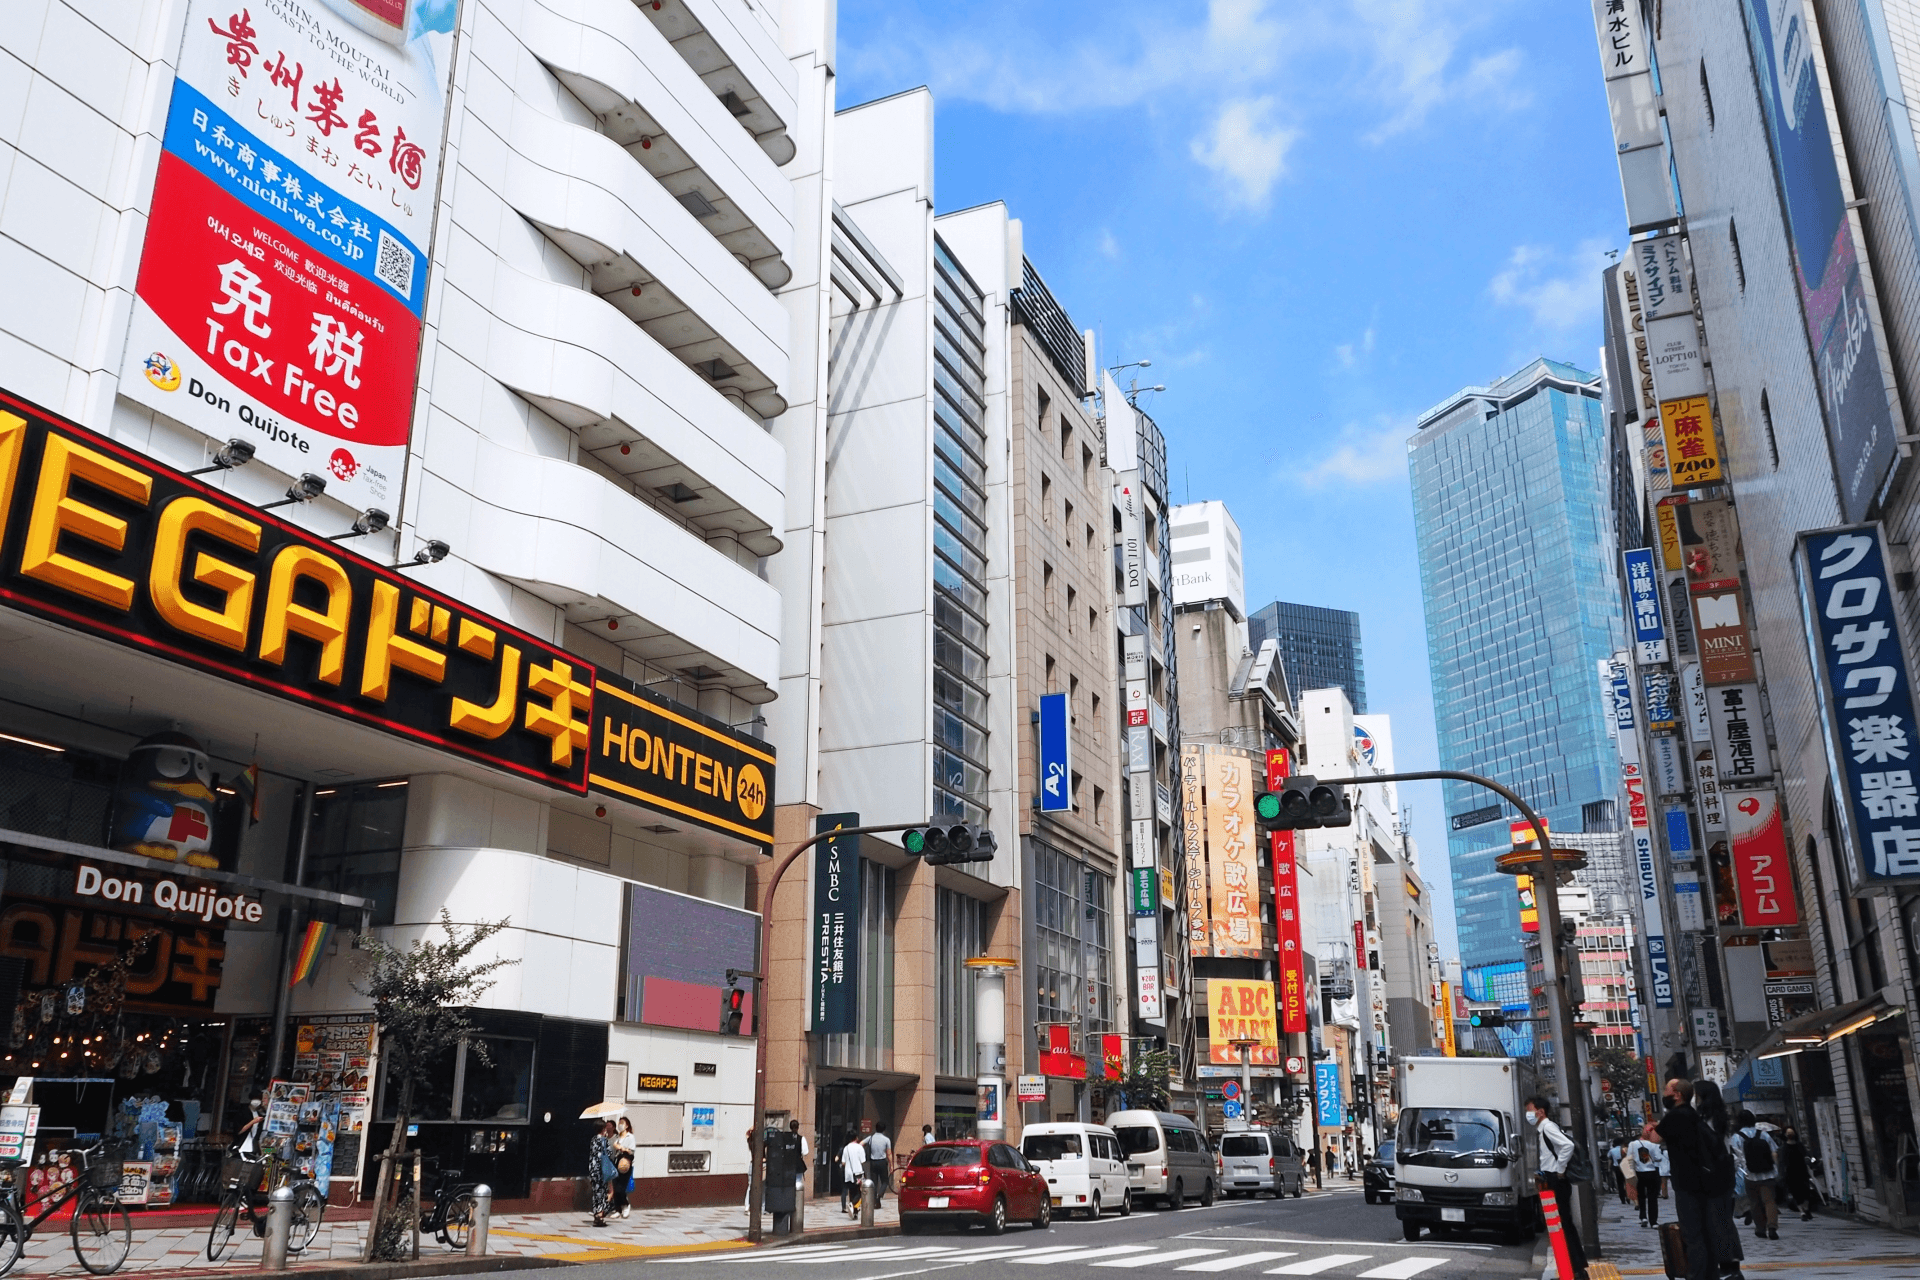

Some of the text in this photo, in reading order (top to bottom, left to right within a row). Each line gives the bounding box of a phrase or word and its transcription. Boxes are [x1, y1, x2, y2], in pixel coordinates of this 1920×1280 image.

[278, 0, 390, 80] HINA MOUTAI
[1606, 0, 1633, 67] 清水ビル
[308, 32, 326, 50] TO
[328, 46, 354, 73] THE
[358, 67, 405, 105] WORLD
[227, 75, 241, 97] き
[306, 135, 338, 167] まお
[347, 162, 383, 191] たい
[192, 107, 373, 242] 日和商事株式会社
[194, 138, 364, 260] www.nichi-wa.co.jp
[207, 216, 266, 261] 어서 오세요
[252, 226, 299, 263] WELCOME
[1663, 240, 1683, 294] ベトナム料理
[211, 258, 366, 390] 免税
[205, 316, 360, 431] Tax Free
[1656, 350, 1697, 365] LOFT101
[1667, 367, 1690, 375] SHIBUYA
[1825, 286, 1868, 441] Fender
[188, 377, 310, 454] Don Quijote
[1664, 402, 1705, 415] フリー
[1674, 415, 1708, 460] 麻雀
[362, 473, 387, 491] Tax-free
[1673, 457, 1715, 475] ZOO
[1684, 472, 1710, 483] 4F
[1667, 497, 1680, 506] 6F
[1660, 509, 1679, 553] エステ
[0, 408, 590, 769] EGAドンキ
[1128, 562, 1139, 588] DOT
[1631, 561, 1659, 631] 洋服の青山
[1644, 641, 1660, 650] 2F
[1646, 652, 1662, 661] 1F
[1703, 634, 1744, 651] MINT
[1613, 685, 1634, 727] LABI
[1819, 534, 1920, 876] クロサワ楽器店
[1721, 688, 1755, 776] 富士屋酒店
[602, 714, 765, 808] HONTEN 24h
[1045, 761, 1065, 797] A2
[1626, 778, 1649, 828] LABI
[1699, 765, 1723, 825] 韓国料理
[828, 846, 841, 902] SMBC
[1220, 762, 1252, 945] カラオケ歌広場
[1637, 838, 1655, 899] SHIBUYA
[76, 865, 263, 923] Don Quijote
[1750, 855, 1780, 915] アコム
[832, 912, 845, 984] 三井住友銀行
[1142, 983, 1155, 991] BAR
[1218, 985, 1270, 1017] ABC
[1285, 968, 1299, 1022] 受付5F
[1650, 957, 1673, 1004] LABI
[1766, 984, 1811, 994] CARD GAMES
[1052, 1046, 1069, 1055] au
[1218, 1017, 1272, 1040] MART
[640, 1076, 677, 1089] MEGAドンキ
[1317, 1068, 1331, 1122] コンタクト
